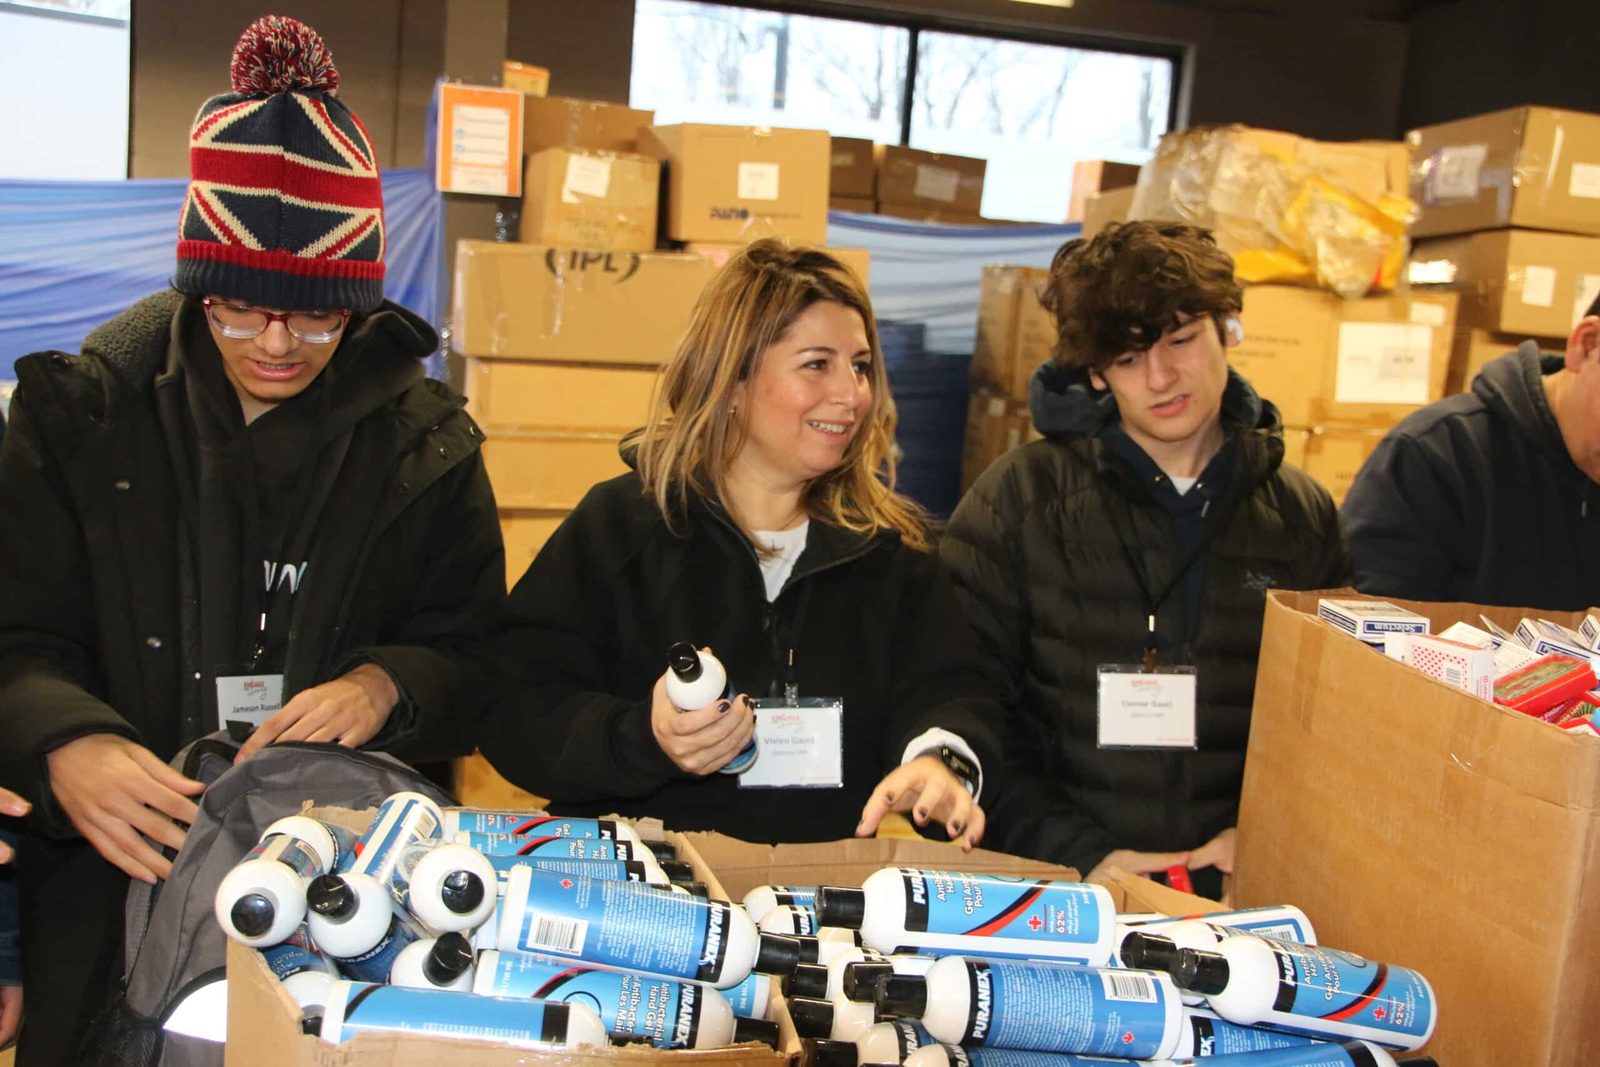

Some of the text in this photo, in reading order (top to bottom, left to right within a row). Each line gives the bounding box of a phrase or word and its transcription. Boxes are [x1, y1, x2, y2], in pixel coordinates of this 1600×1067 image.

[963, 897, 974, 915] Gel
[974, 886, 983, 907] Pour
[1056, 910, 1065, 934] 62%
[1324, 982, 1333, 1001] Gel
[1332, 971, 1341, 993] Pour
[619, 991, 630, 1006] Les
[644, 986, 660, 1031] Hand Gel
[972, 965, 992, 1038] PURANEX
[654, 982, 670, 1041] Antibacterial
[673, 983, 695, 1046] PURANEX
[1395, 1002, 1406, 1025] 62%
